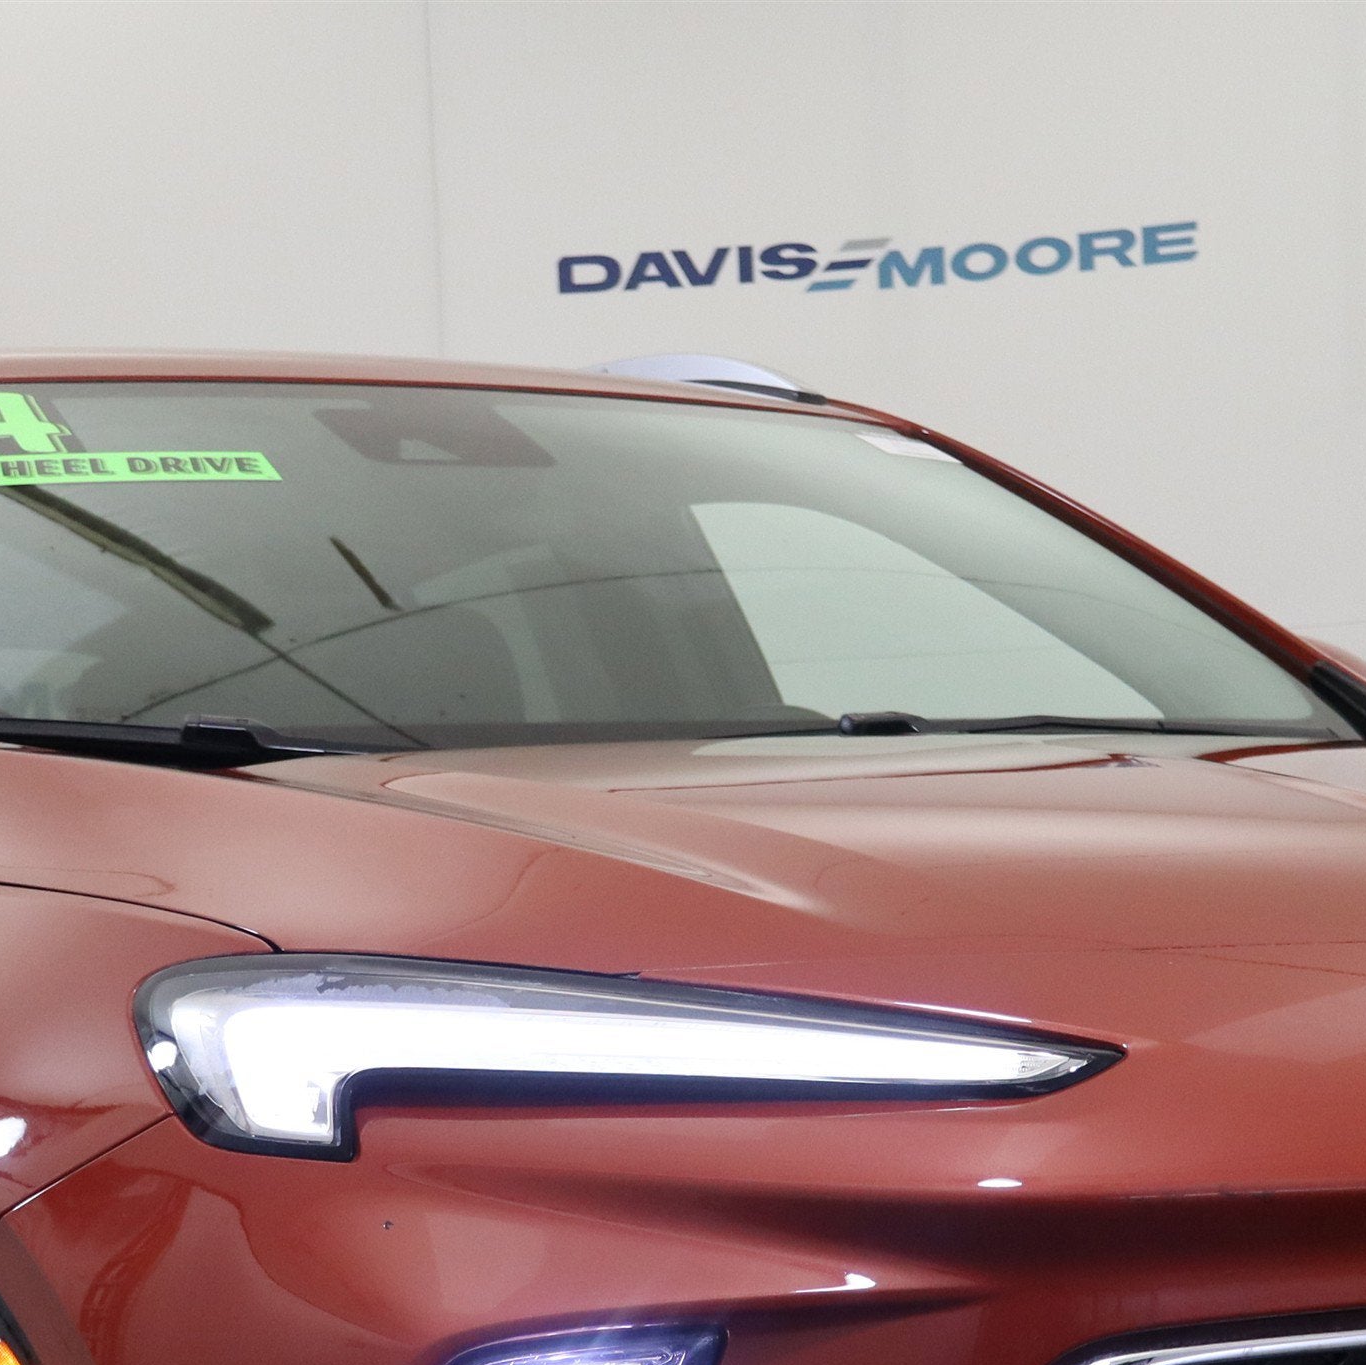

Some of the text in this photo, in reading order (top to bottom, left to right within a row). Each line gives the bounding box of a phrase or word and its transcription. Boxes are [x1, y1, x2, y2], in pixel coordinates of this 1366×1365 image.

[556, 220, 1199, 296] DAVIS MOORE
[125, 456, 264, 475] DRIVE
